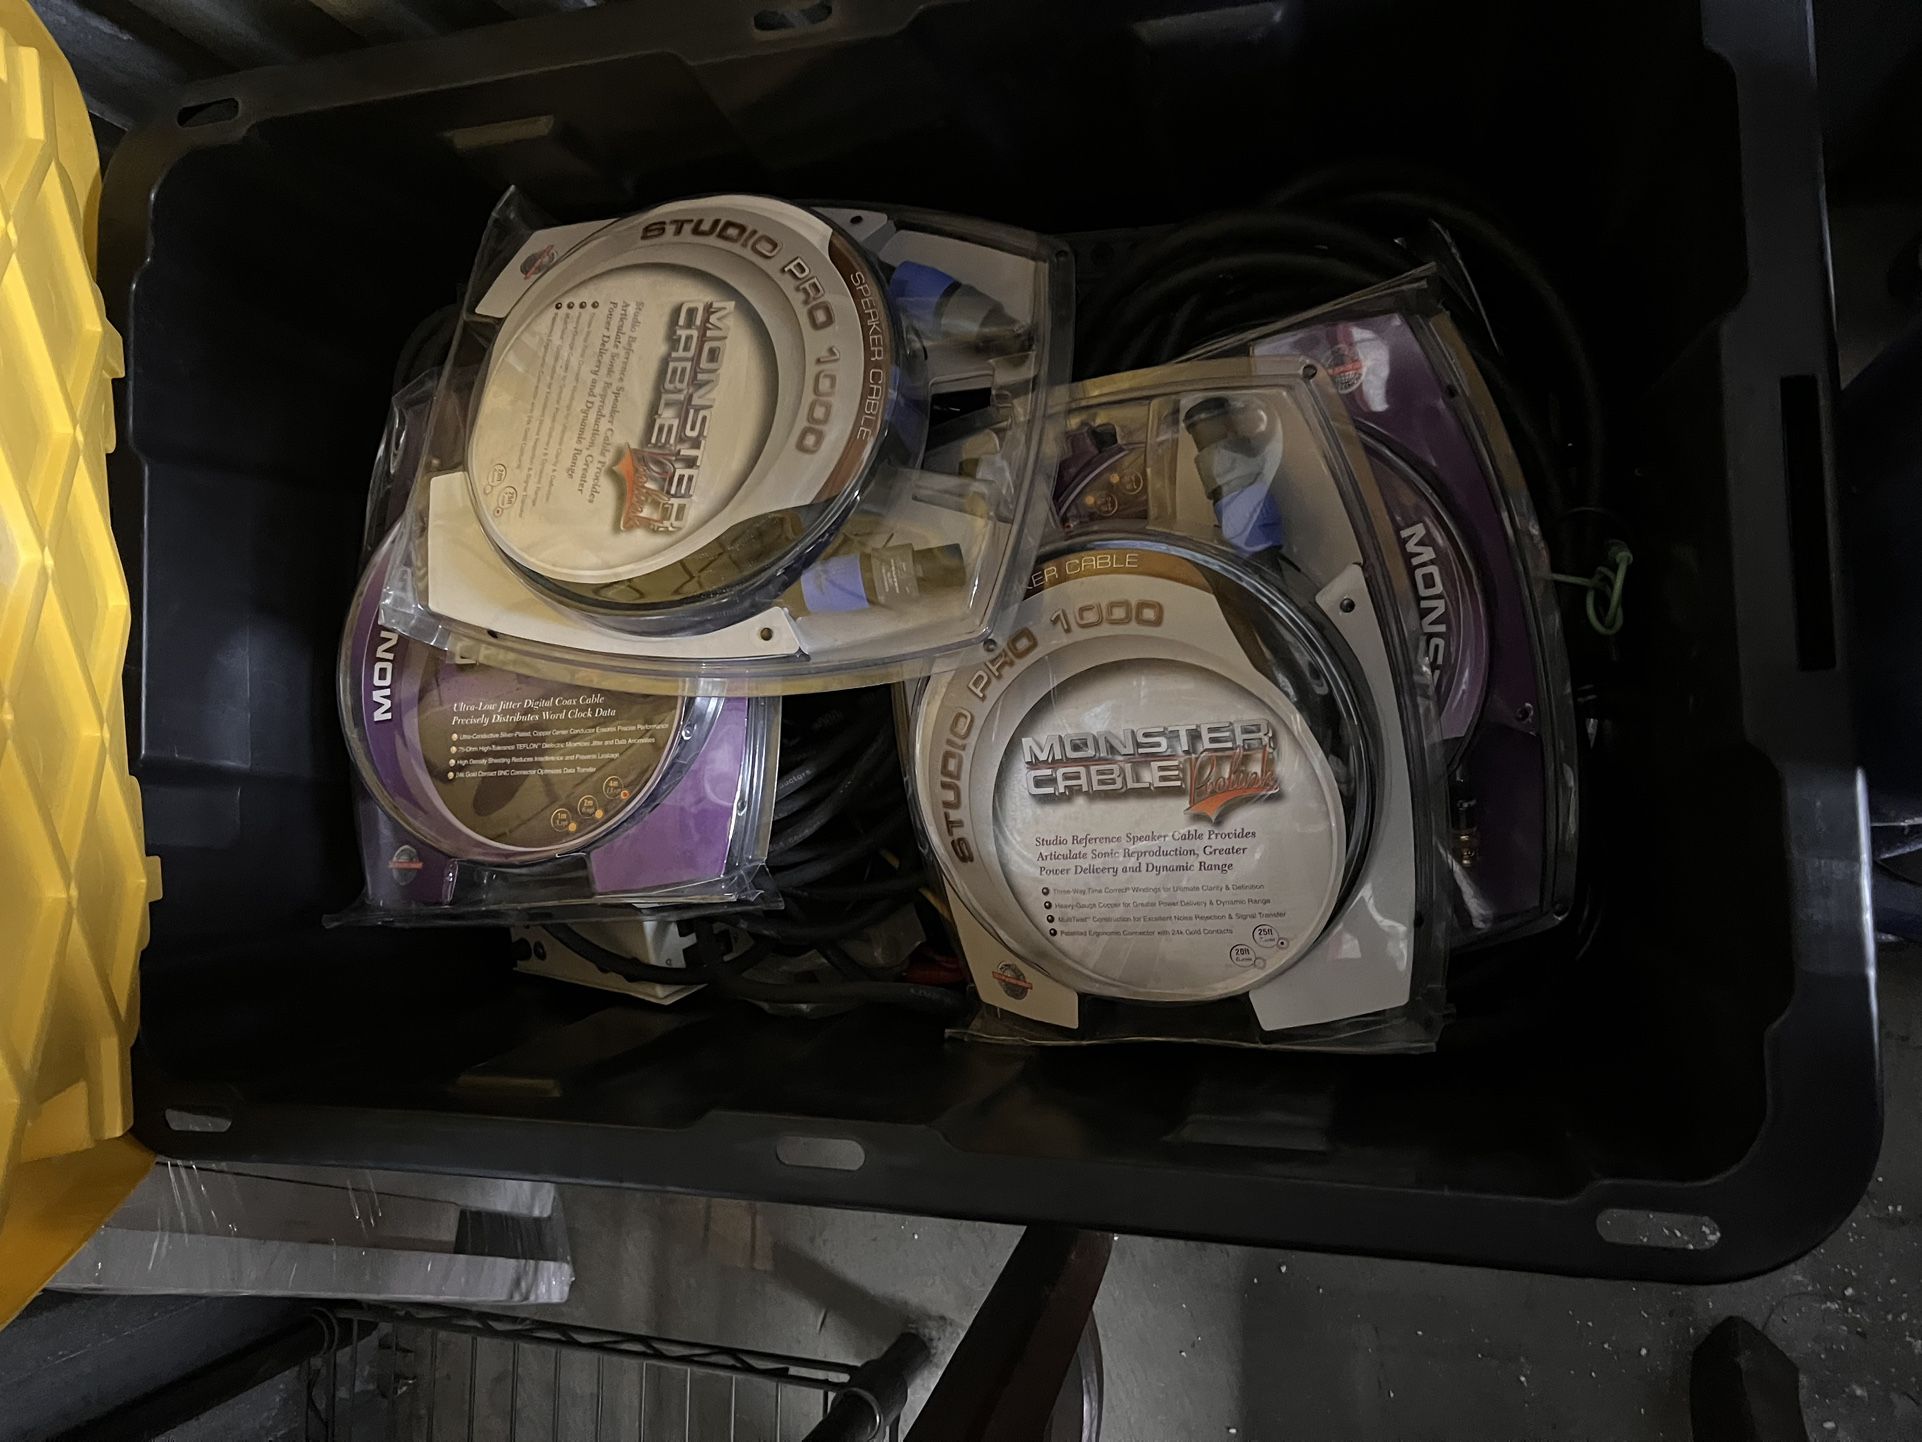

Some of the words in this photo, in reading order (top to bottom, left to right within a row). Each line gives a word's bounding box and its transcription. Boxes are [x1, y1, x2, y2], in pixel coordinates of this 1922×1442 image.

[641, 218, 783, 258] STUDIO
[784, 257, 835, 331] PRO
[603, 299, 617, 333] Power
[612, 299, 630, 350] Articulate
[630, 300, 644, 334] Studio
[851, 271, 883, 361] SPEAKER
[591, 333, 609, 377] Delivery
[605, 350, 617, 379] Sonic
[616, 333, 635, 383] Reference
[649, 302, 704, 447] CABLE
[587, 377, 598, 398] and
[605, 384, 623, 426] Speaker
[795, 346, 840, 455] 1000
[857, 368, 884, 440] CABLE
[574, 398, 592, 446] Dynamic
[585, 379, 611, 452] Reproduction,
[658, 301, 735, 532] MONSTER
[600, 426, 613, 457] Cable
[566, 446, 580, 480] Range
[577, 452, 593, 495] Greater
[588, 459, 604, 505] Provides
[1065, 553, 1139, 575] CABLE
[451, 713, 490, 728] Precisely
[491, 711, 539, 724] Distributes
[541, 709, 565, 720] Word
[567, 708, 592, 719] Clock
[594, 706, 616, 717] Data
[452, 699, 497, 713] Ultra-Low
[497, 699, 522, 712] Jitter
[522, 697, 554, 710] Digital
[554, 695, 576, 706] Coax
[579, 693, 605, 705] Cable
[941, 709, 975, 863] STUDIO
[968, 627, 1038, 701] PRO
[1050, 599, 1164, 634] 1000
[1021, 719, 1275, 764] MONSTER
[1026, 760, 1184, 796] CABLE
[1034, 835, 1067, 847] Studio
[1071, 832, 1122, 847] Reference
[1126, 831, 1168, 846] Speaker
[1171, 830, 1204, 842] Cable
[1207, 828, 1256, 841] Provides
[1036, 849, 1088, 862] Articulate
[1090, 848, 1119, 860] Sonic
[1122, 845, 1199, 861] Reproduction,
[1202, 843, 1248, 856] Greater
[1038, 865, 1071, 876] Power
[1074, 863, 1118, 878] Delivery
[1121, 862, 1141, 874] and
[1144, 860, 1194, 875] Dynamic
[1197, 860, 1233, 873] Range
[1200, 884, 1223, 892] Clarity
[1227, 912, 1233, 920] &
[1234, 912, 1257, 920] Signal
